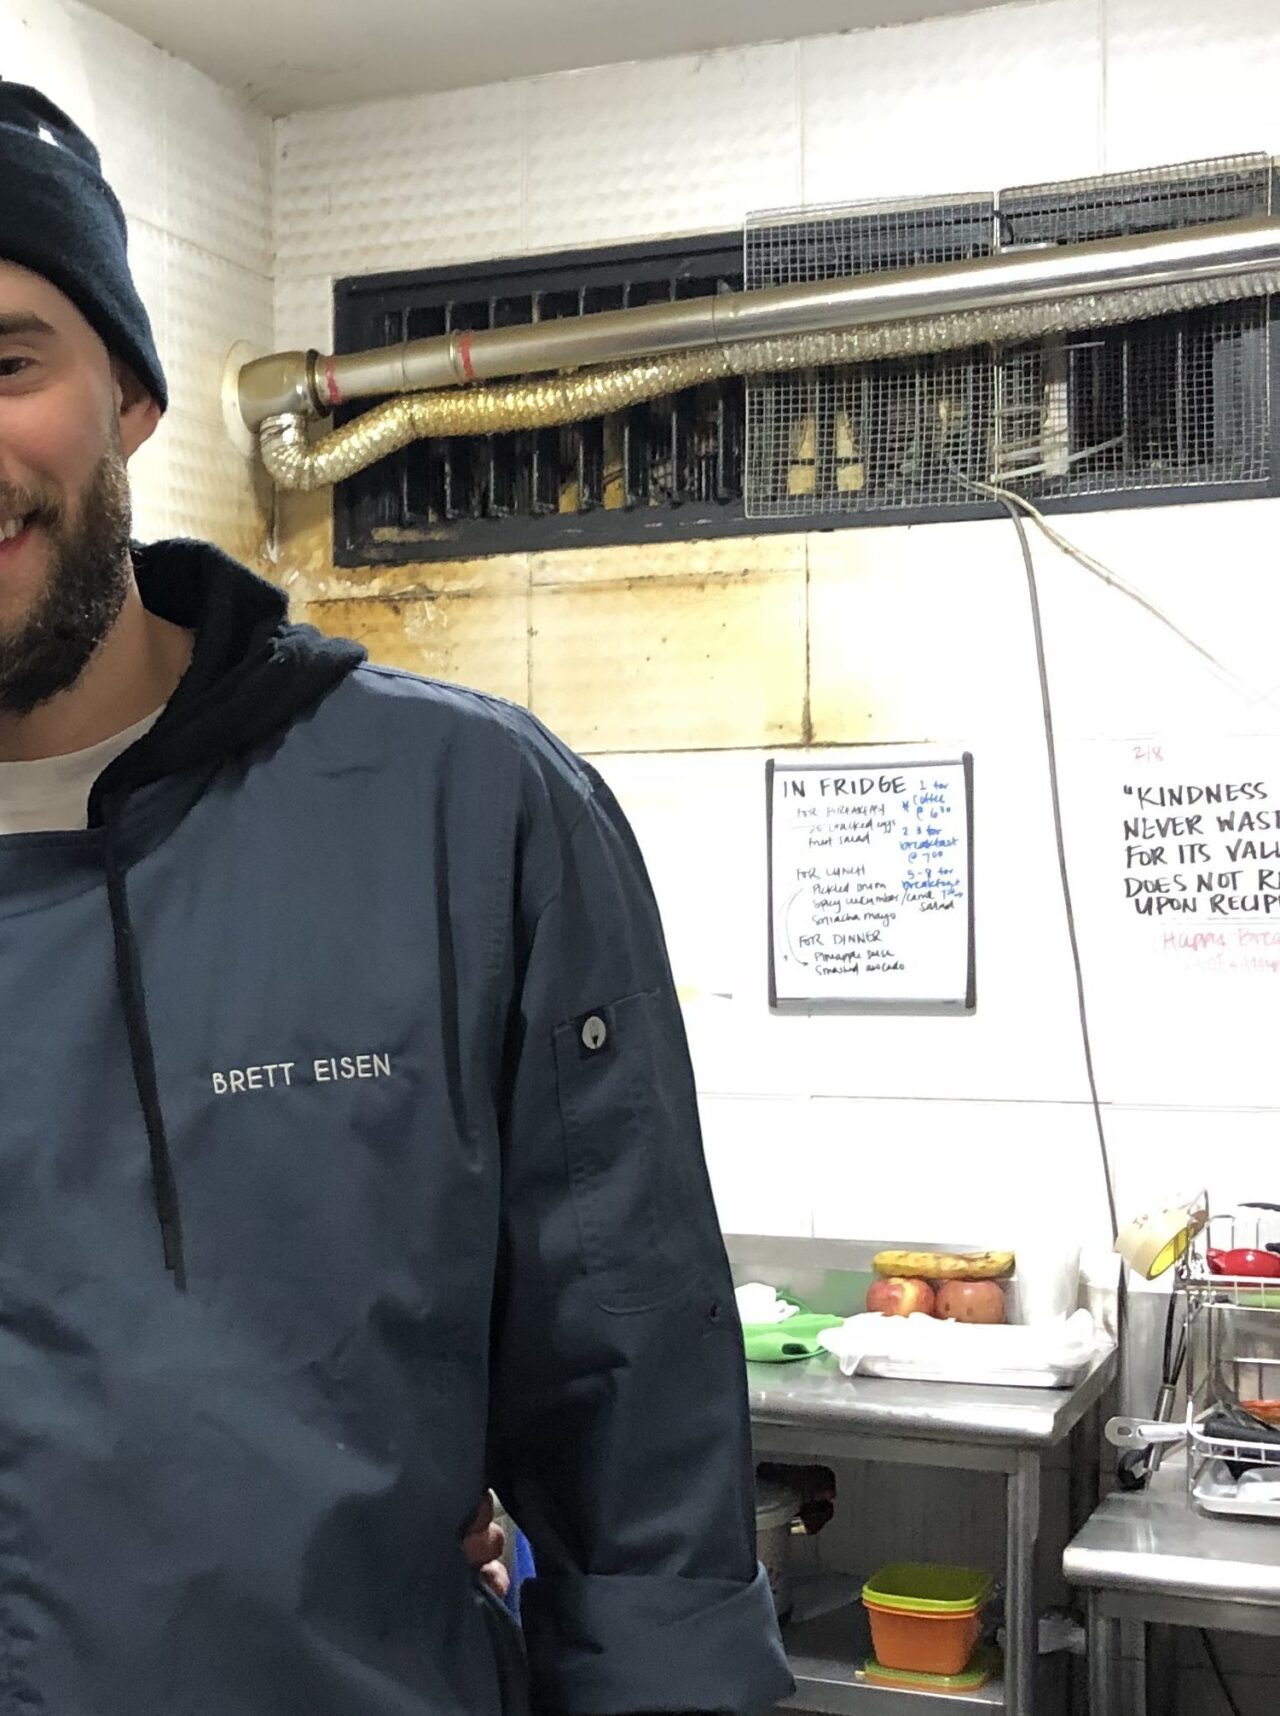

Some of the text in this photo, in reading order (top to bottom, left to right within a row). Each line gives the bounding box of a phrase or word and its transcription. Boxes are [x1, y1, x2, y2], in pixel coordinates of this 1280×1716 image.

[783, 775, 907, 798] IN FRIDGE
[1123, 815, 1205, 841] NEVER
[1125, 845, 1168, 868] FOR
[1178, 843, 1212, 864] ITS
[796, 864, 866, 880] FOR LUNCH
[1123, 874, 1188, 898] DOES
[1196, 870, 1245, 893] NOT
[1134, 896, 1198, 917] UPON
[799, 929, 883, 948] FOR DINNER
[212, 1053, 391, 1094] BRETT EISEN
